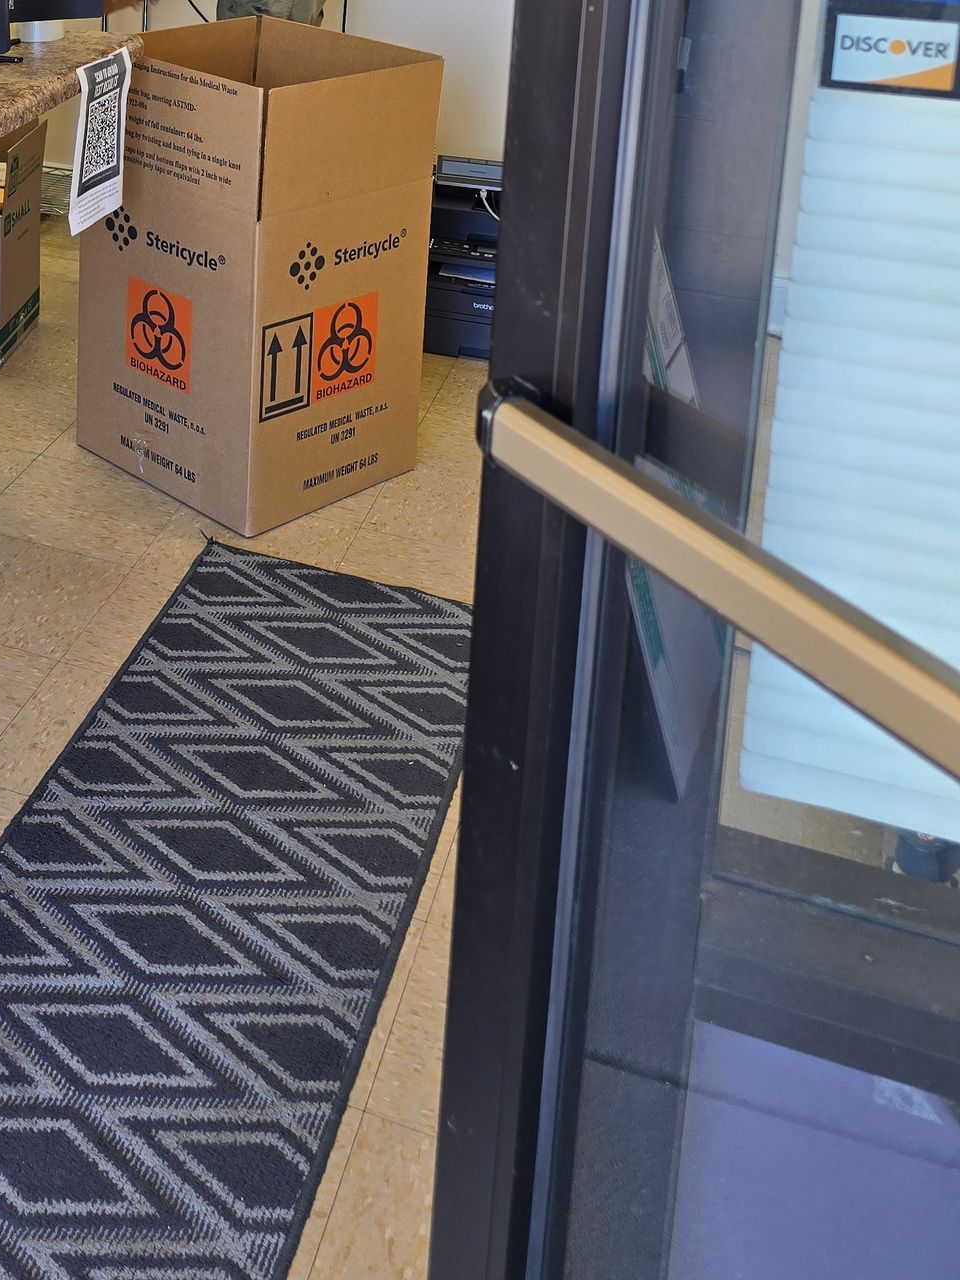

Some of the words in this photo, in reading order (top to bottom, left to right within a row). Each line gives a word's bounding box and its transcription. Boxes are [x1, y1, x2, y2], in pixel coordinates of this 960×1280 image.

[840, 34, 949, 59] DISCOVER
[150, 64, 180, 80] Instructions
[180, 72, 189, 82] for
[189, 75, 199, 85] this
[199, 77, 221, 91] Medical
[221, 83, 238, 96] Waste
[151, 94, 173, 107] meeting
[128, 115, 145, 125] weight
[150, 120, 160, 131] full
[160, 123, 186, 138] container:
[186, 131, 194, 141] 64
[193, 133, 204, 144] lbs.
[136, 147, 145, 158] top
[145, 150, 156, 161] and
[156, 153, 174, 167] bottom
[174, 158, 188, 172] flaps
[188, 164, 201, 176] with
[205, 170, 218, 181] inch
[218, 175, 232, 186] wide
[142, 133, 162, 148] twisting
[162, 139, 172, 150] and
[173, 142, 186, 154] hand
[186, 148, 200, 160] tying
[211, 154, 228, 168] single
[228, 158, 241, 171] knot
[142, 161, 154, 171] poly
[154, 163, 166, 174] tape
[173, 170, 201, 186] equivalent
[11, 199, 31, 228] SMALL
[473, 302, 495, 311] brothe
[130, 356, 187, 391] BIOHAZARD
[315, 373, 373, 401] BIOHAZARD
[113, 382, 142, 404] REGULATED
[142, 397, 166, 417] MEDICAL
[168, 410, 189, 430] WASTE,
[189, 422, 206, 436] n.o.s.
[144, 412, 153, 426] UN
[154, 417, 169, 434] 3291
[296, 422, 328, 442] REGULATED
[329, 413, 353, 430] MEDICAL
[355, 406, 375, 421] WASTE,
[375, 402, 389, 414] n.o.s.
[330, 431, 340, 445] UN
[340, 426, 356, 442] 3291
[150, 450, 174, 472] WEIGHT
[174, 463, 183, 477] 64
[183, 468, 196, 483] LBS
[303, 469, 335, 491] MAXIMUM
[335, 460, 359, 479] WEIGHT
[359, 457, 367, 470] 64
[367, 451, 379, 466] LBS
